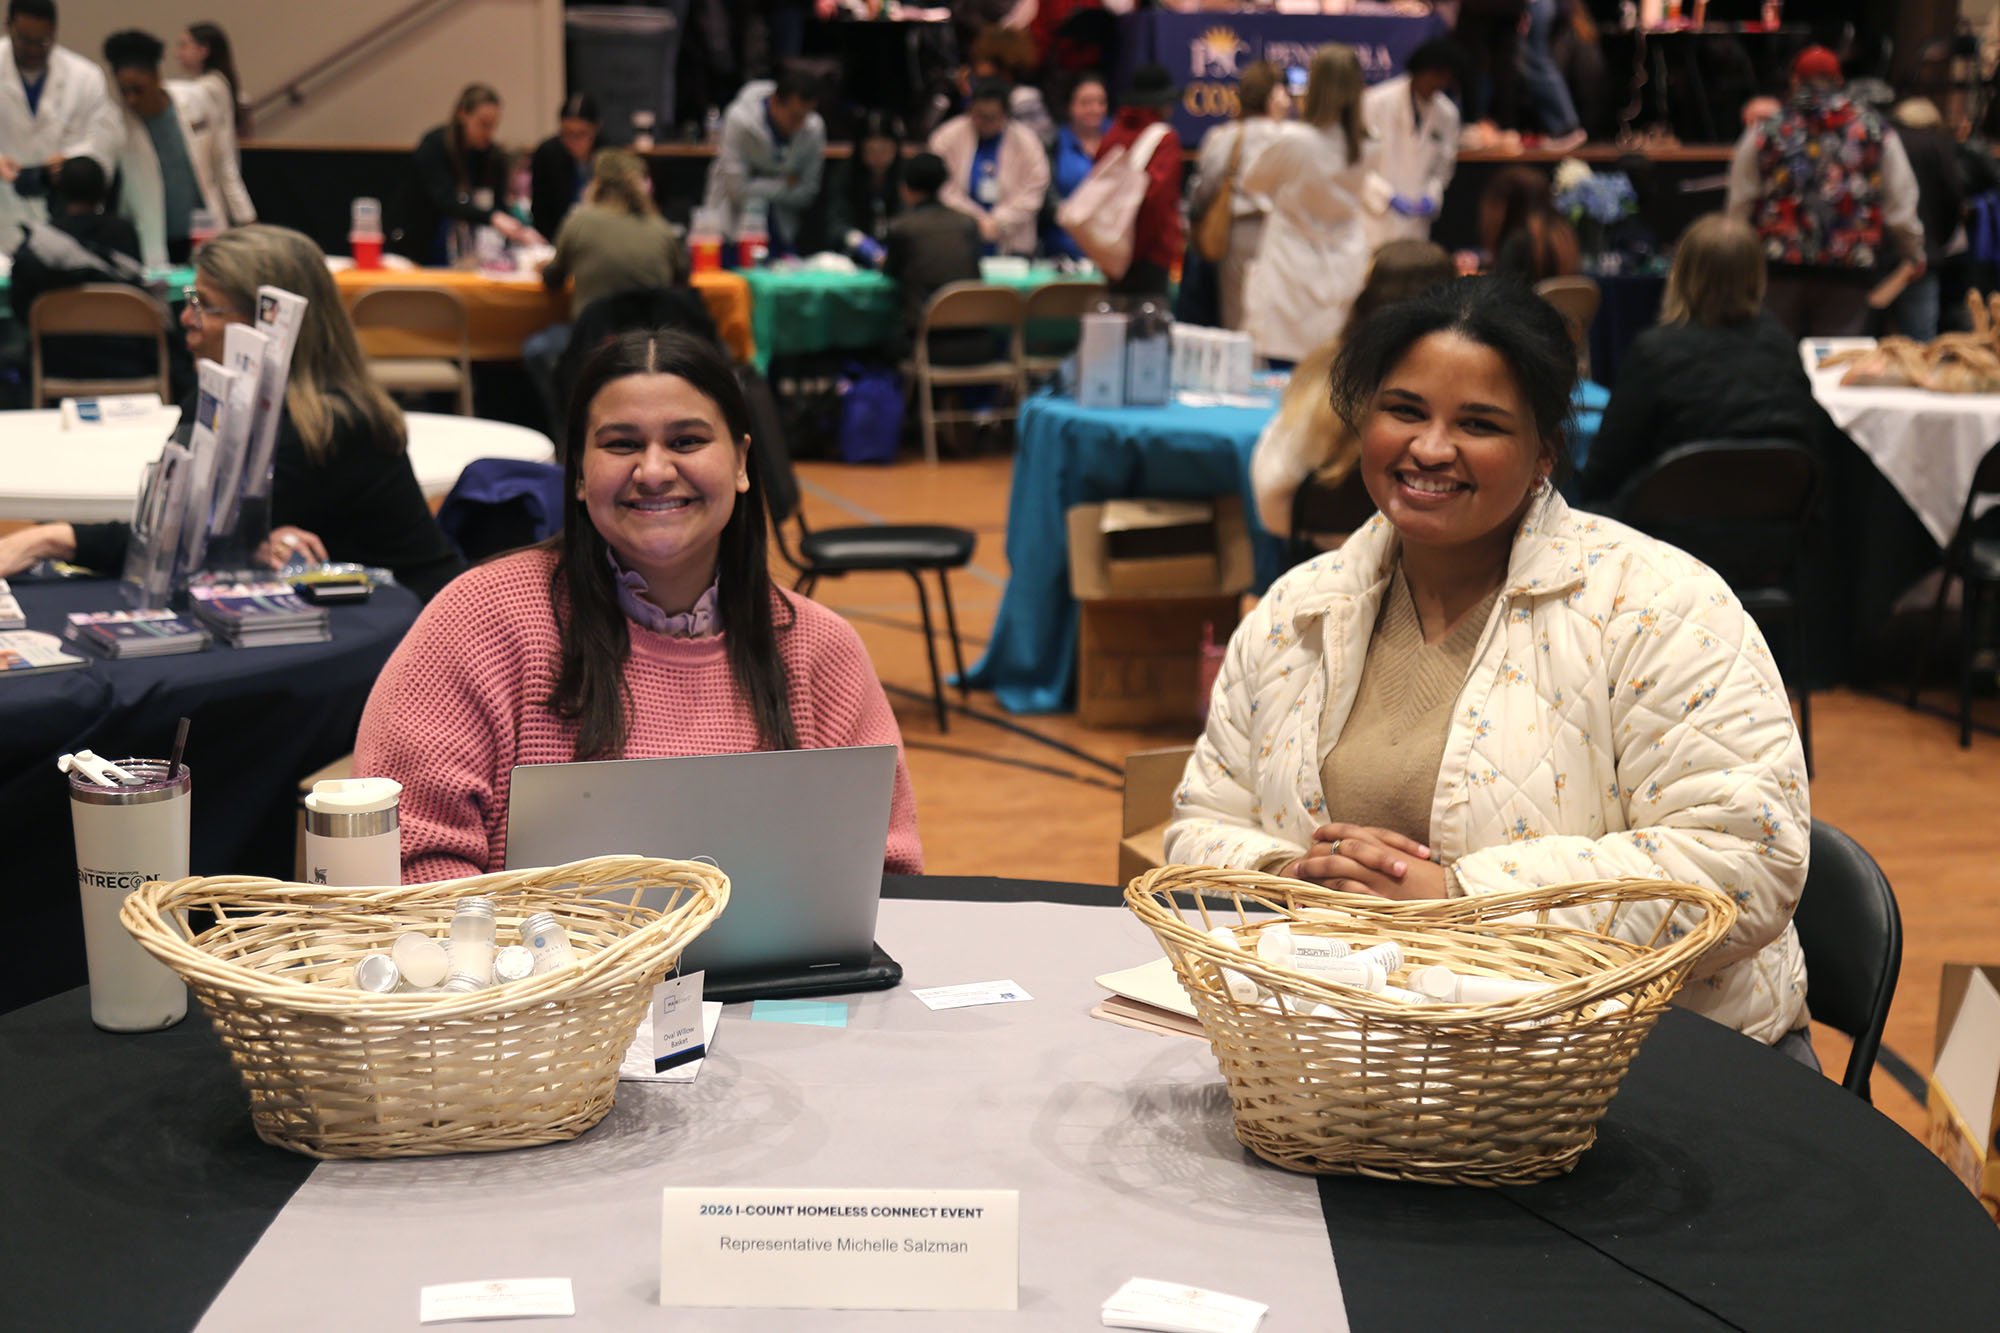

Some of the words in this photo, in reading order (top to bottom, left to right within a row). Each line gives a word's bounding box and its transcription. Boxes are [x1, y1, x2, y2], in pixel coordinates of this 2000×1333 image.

[700, 1204, 733, 1216] 2026
[735, 1204, 794, 1217] I-COUNT
[797, 1205, 868, 1218] HOMELESS
[870, 1206, 937, 1219] CONNECT
[940, 1207, 984, 1219] EVENT
[720, 1236, 832, 1253] Representative
[837, 1237, 899, 1253] Michelle
[903, 1238, 968, 1254] Salzman
